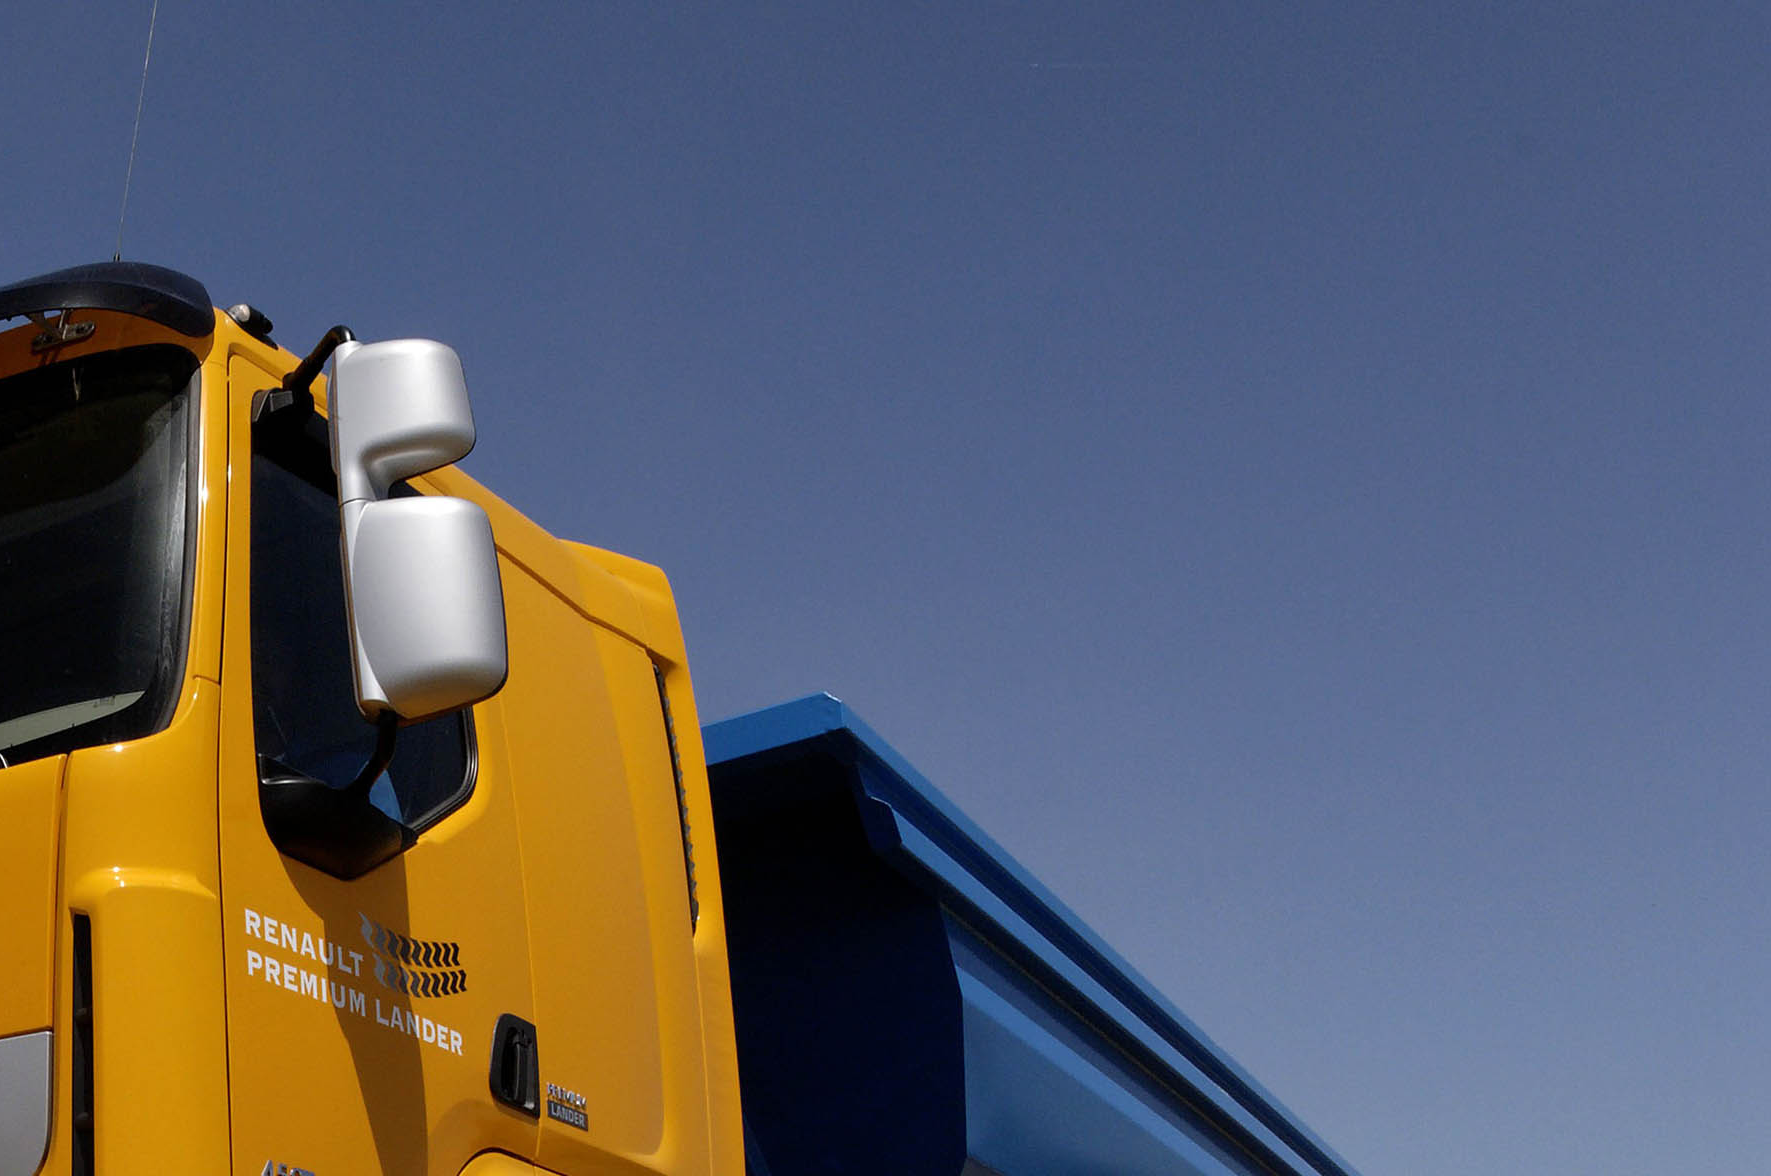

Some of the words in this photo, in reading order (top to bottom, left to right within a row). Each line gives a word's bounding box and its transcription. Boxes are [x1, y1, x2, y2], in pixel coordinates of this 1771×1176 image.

[244, 908, 364, 977] RENAULT
[246, 949, 366, 1018] PREMIUM
[375, 999, 464, 1056] LANDER
